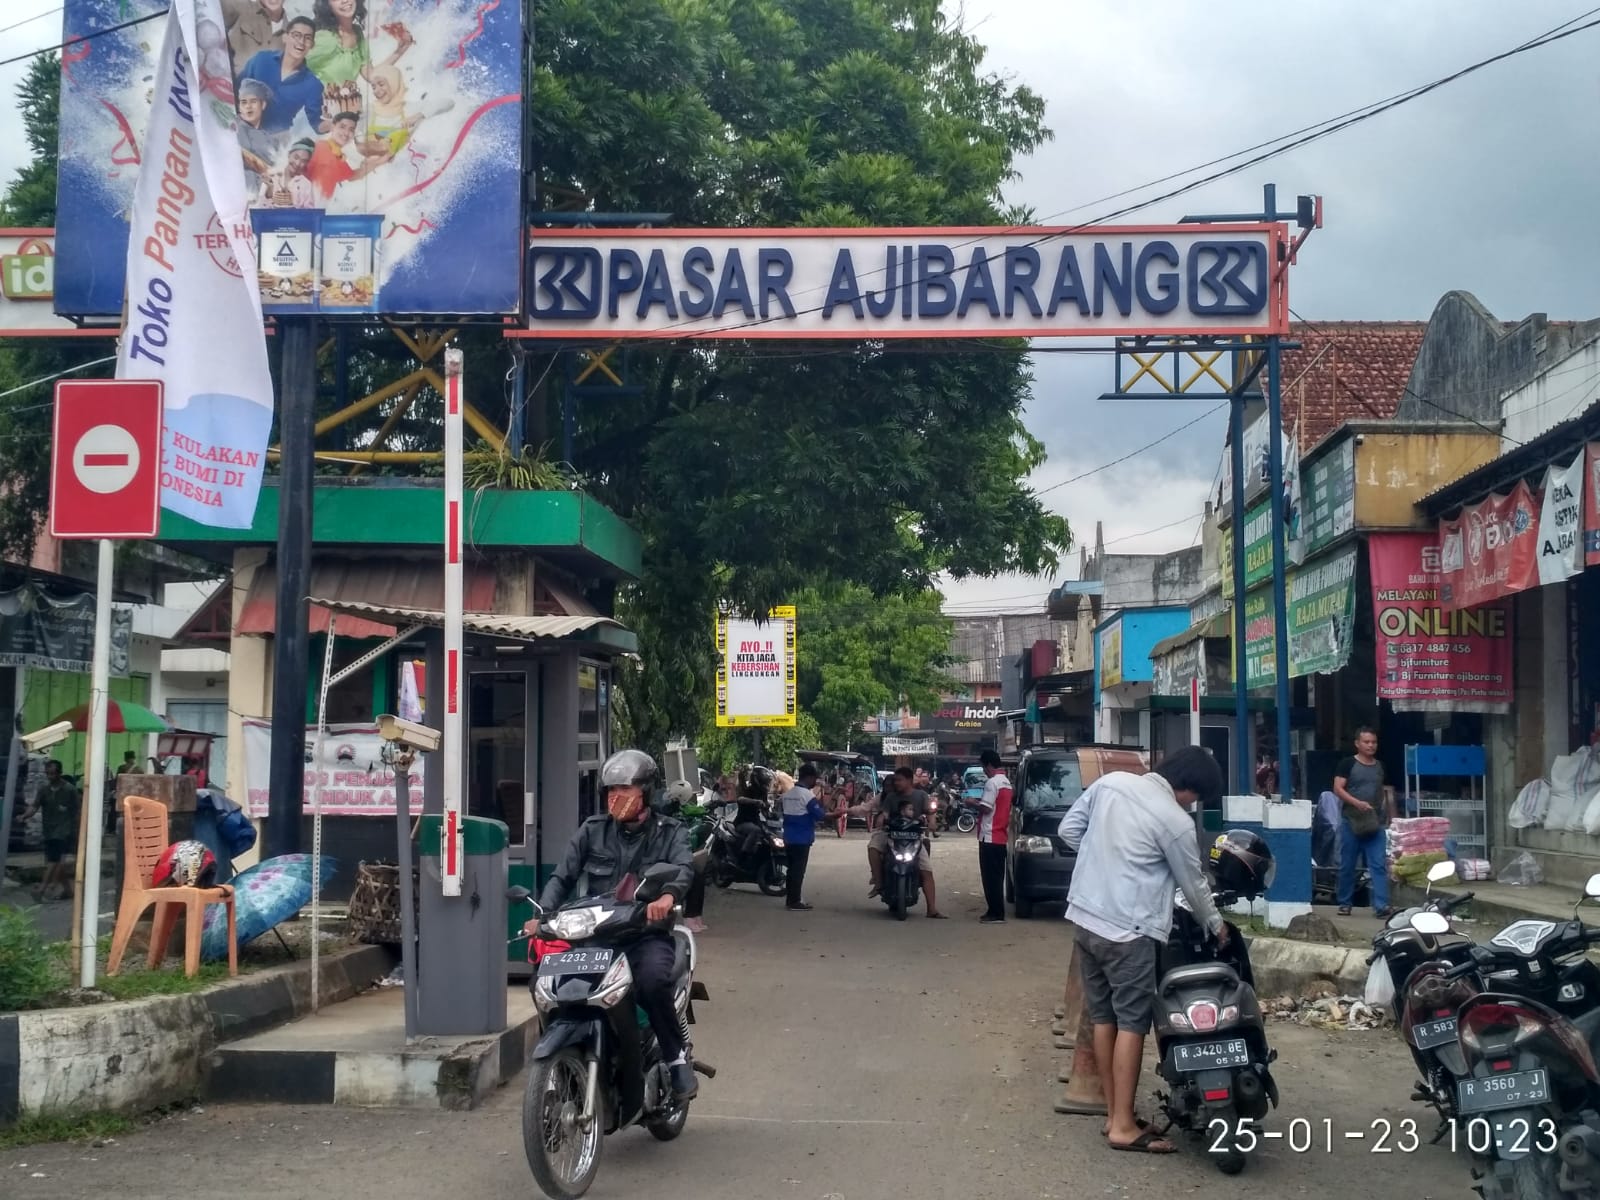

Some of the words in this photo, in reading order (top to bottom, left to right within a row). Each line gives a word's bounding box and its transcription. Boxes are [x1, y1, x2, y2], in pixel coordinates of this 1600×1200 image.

[144, 127, 195, 272] Pangan
[608, 246, 797, 319] PASAR
[822, 240, 1180, 319] AJIBARANG
[131, 277, 172, 366] Toko
[172, 431, 259, 468] KULAKAN
[174, 454, 219, 484] BUMI
[223, 470, 246, 488] DI
[1377, 589, 1437, 601] MELAYANI
[1378, 606, 1506, 638] ONLINE
[1400, 643, 1423, 654] 0817
[1426, 643, 1450, 652] 4847
[1452, 645, 1471, 654] 456
[736, 653, 755, 662] KITA
[755, 653, 776, 662] JAGA
[1400, 658, 1449, 668] bjfurniture
[731, 662, 780, 671] KEBERSIHAN
[1401, 671, 1412, 681] Bj
[1413, 671, 1455, 680] Furniture
[1456, 671, 1503, 683] ajibarang
[954, 720, 982, 728] Fashion
[543, 955, 551, 965] R
[560, 952, 587, 962] 4232
[594, 951, 609, 961] UA
[1420, 1026, 1428, 1037] R
[1181, 1047, 1188, 1058] R
[1467, 1083, 1474, 1095] R
[1484, 1077, 1515, 1092] 3560
[1531, 1073, 1539, 1086] J
